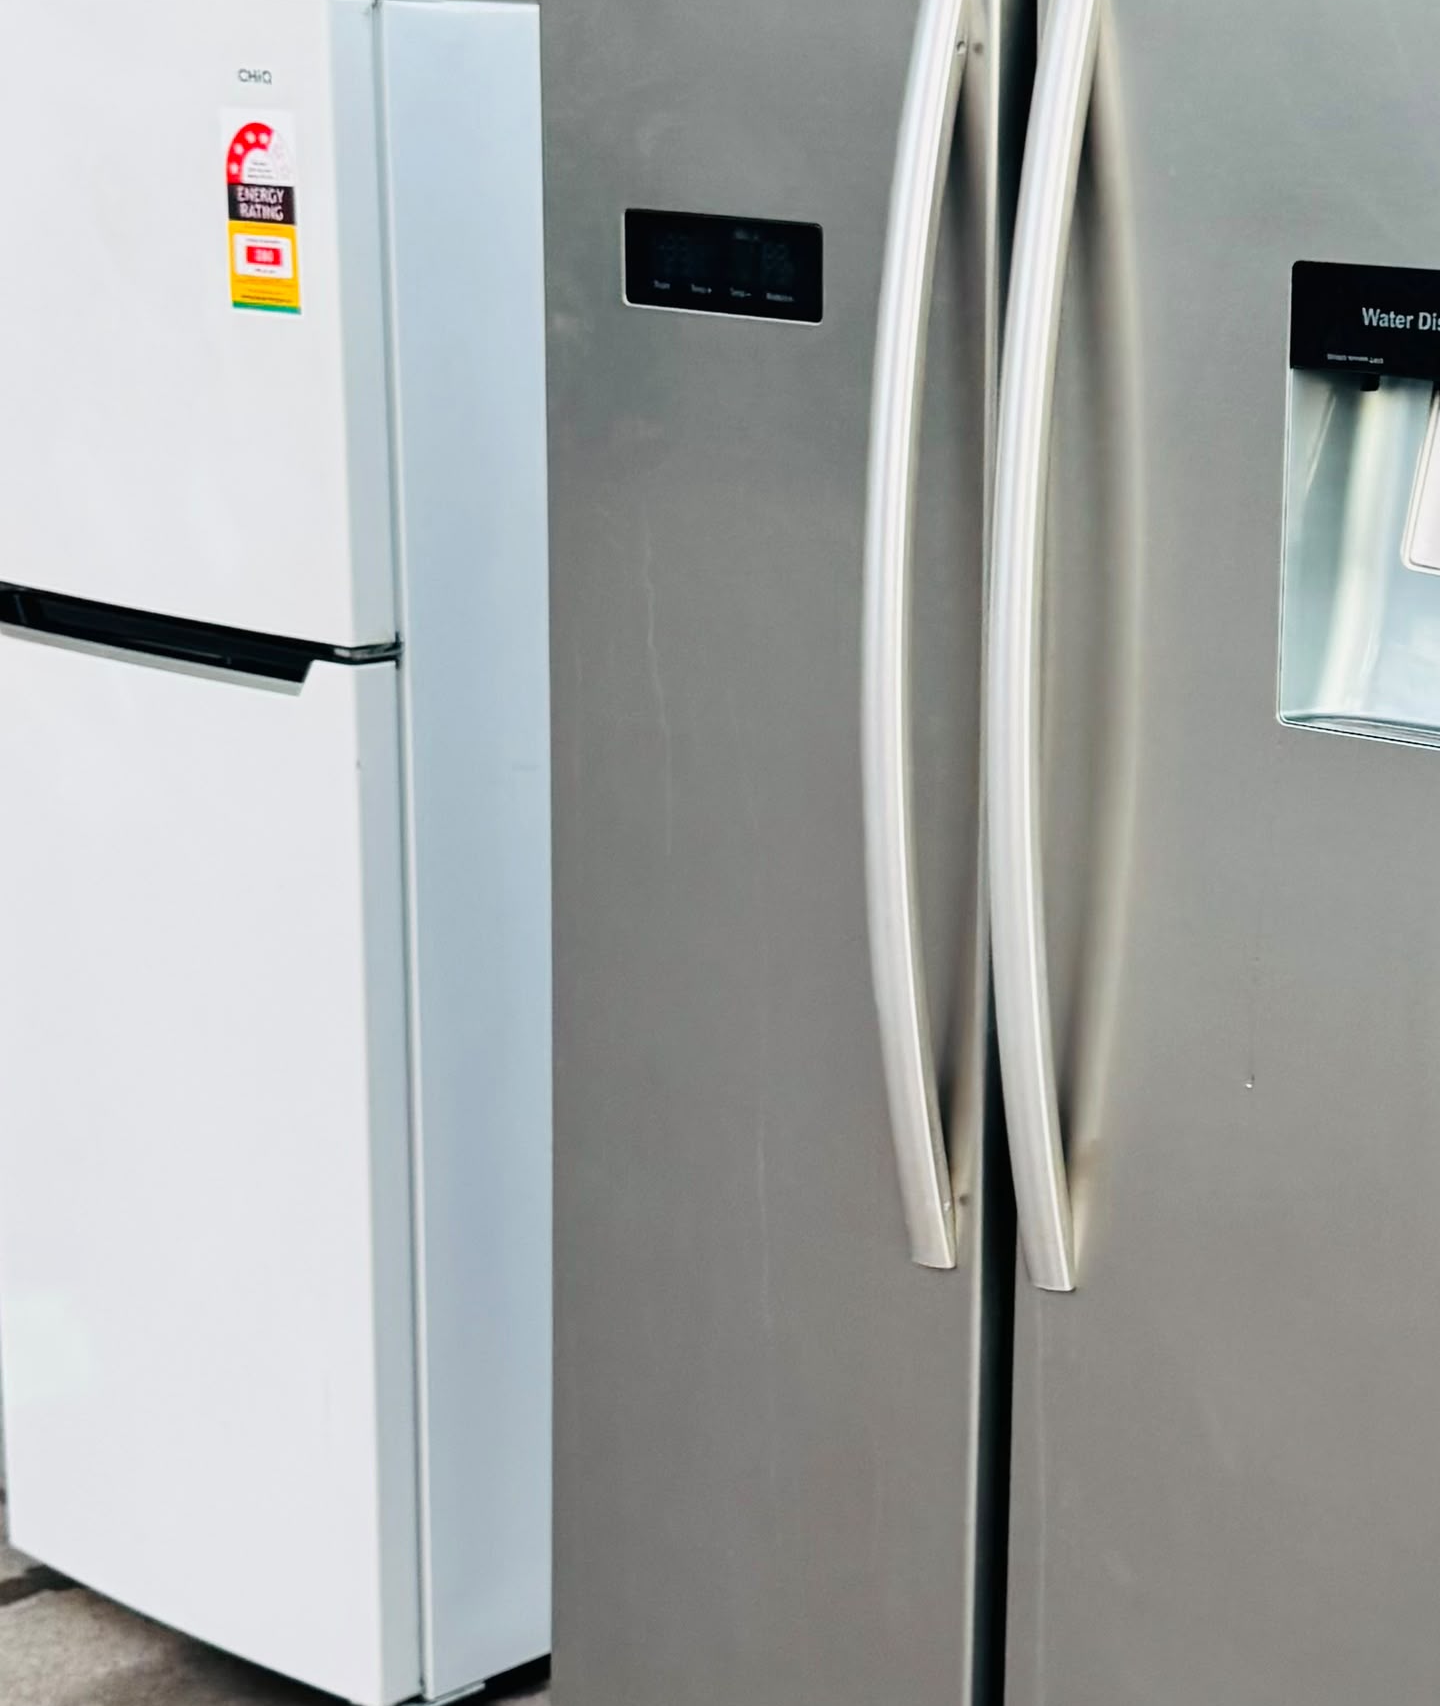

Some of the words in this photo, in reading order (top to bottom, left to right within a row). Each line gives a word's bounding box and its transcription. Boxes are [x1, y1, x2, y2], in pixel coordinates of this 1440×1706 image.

[237, 185, 284, 204] ENERGY
[240, 203, 284, 221] RATING
[1361, 307, 1414, 330] Water
